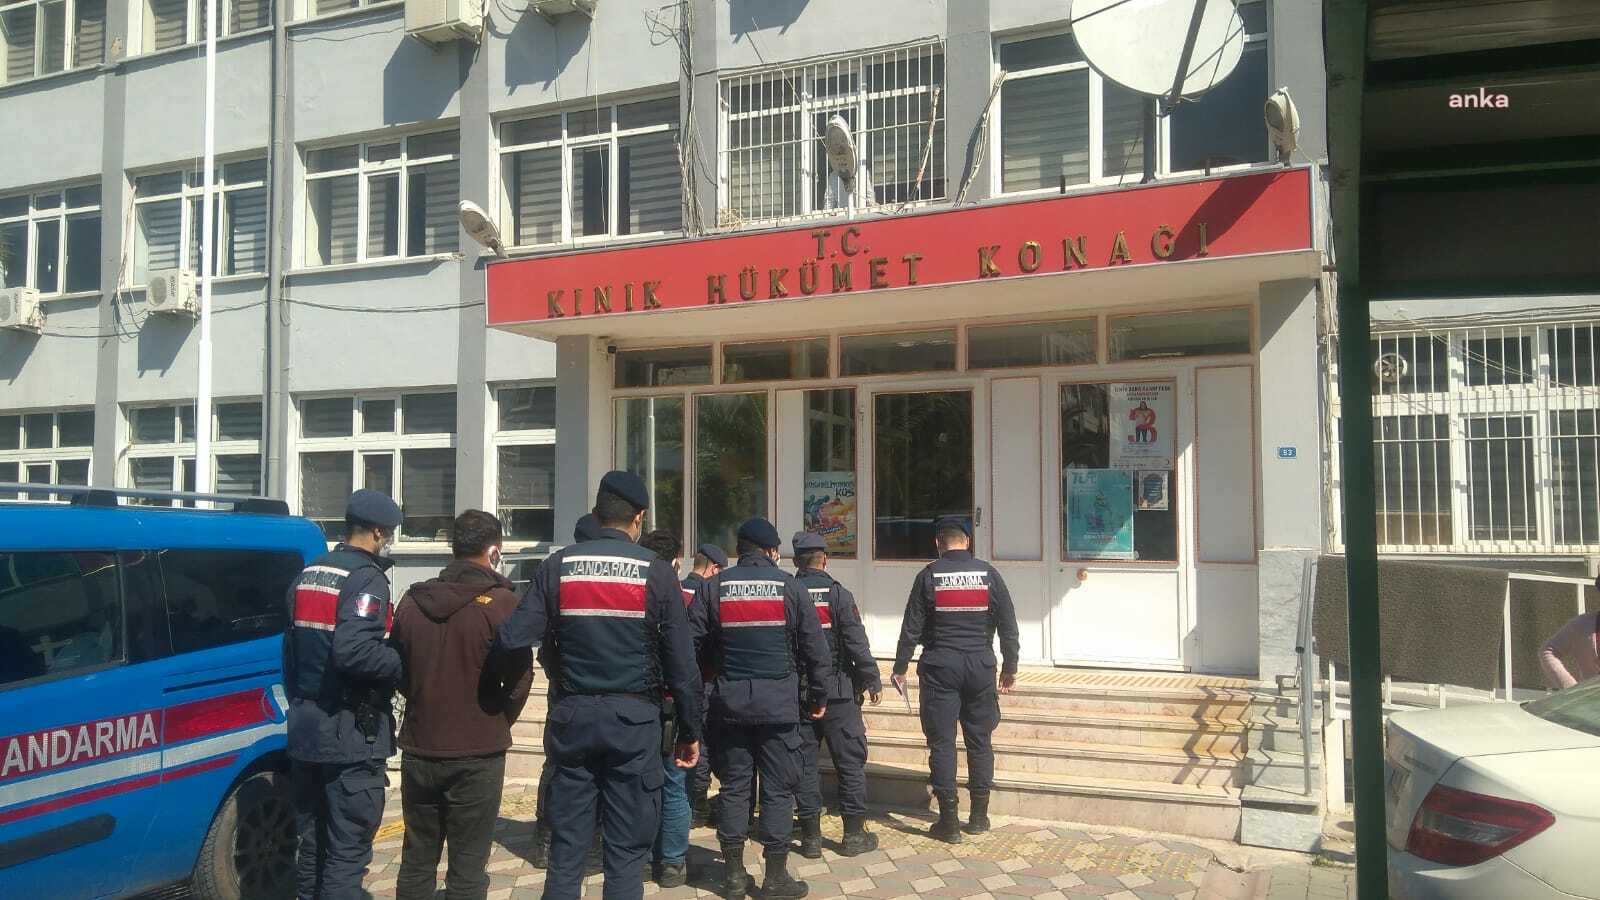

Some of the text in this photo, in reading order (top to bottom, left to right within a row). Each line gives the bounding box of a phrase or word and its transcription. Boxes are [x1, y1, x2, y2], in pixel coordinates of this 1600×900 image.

[811, 226, 871, 260] T.C.
[547, 223, 1209, 318] KINIK HÜKÜMET KONAĞI
[569, 560, 641, 578] JANDARMA
[940, 575, 984, 586] JANDARMA
[726, 584, 778, 597] JANDARMA
[0, 713, 158, 777] ANDARMA
